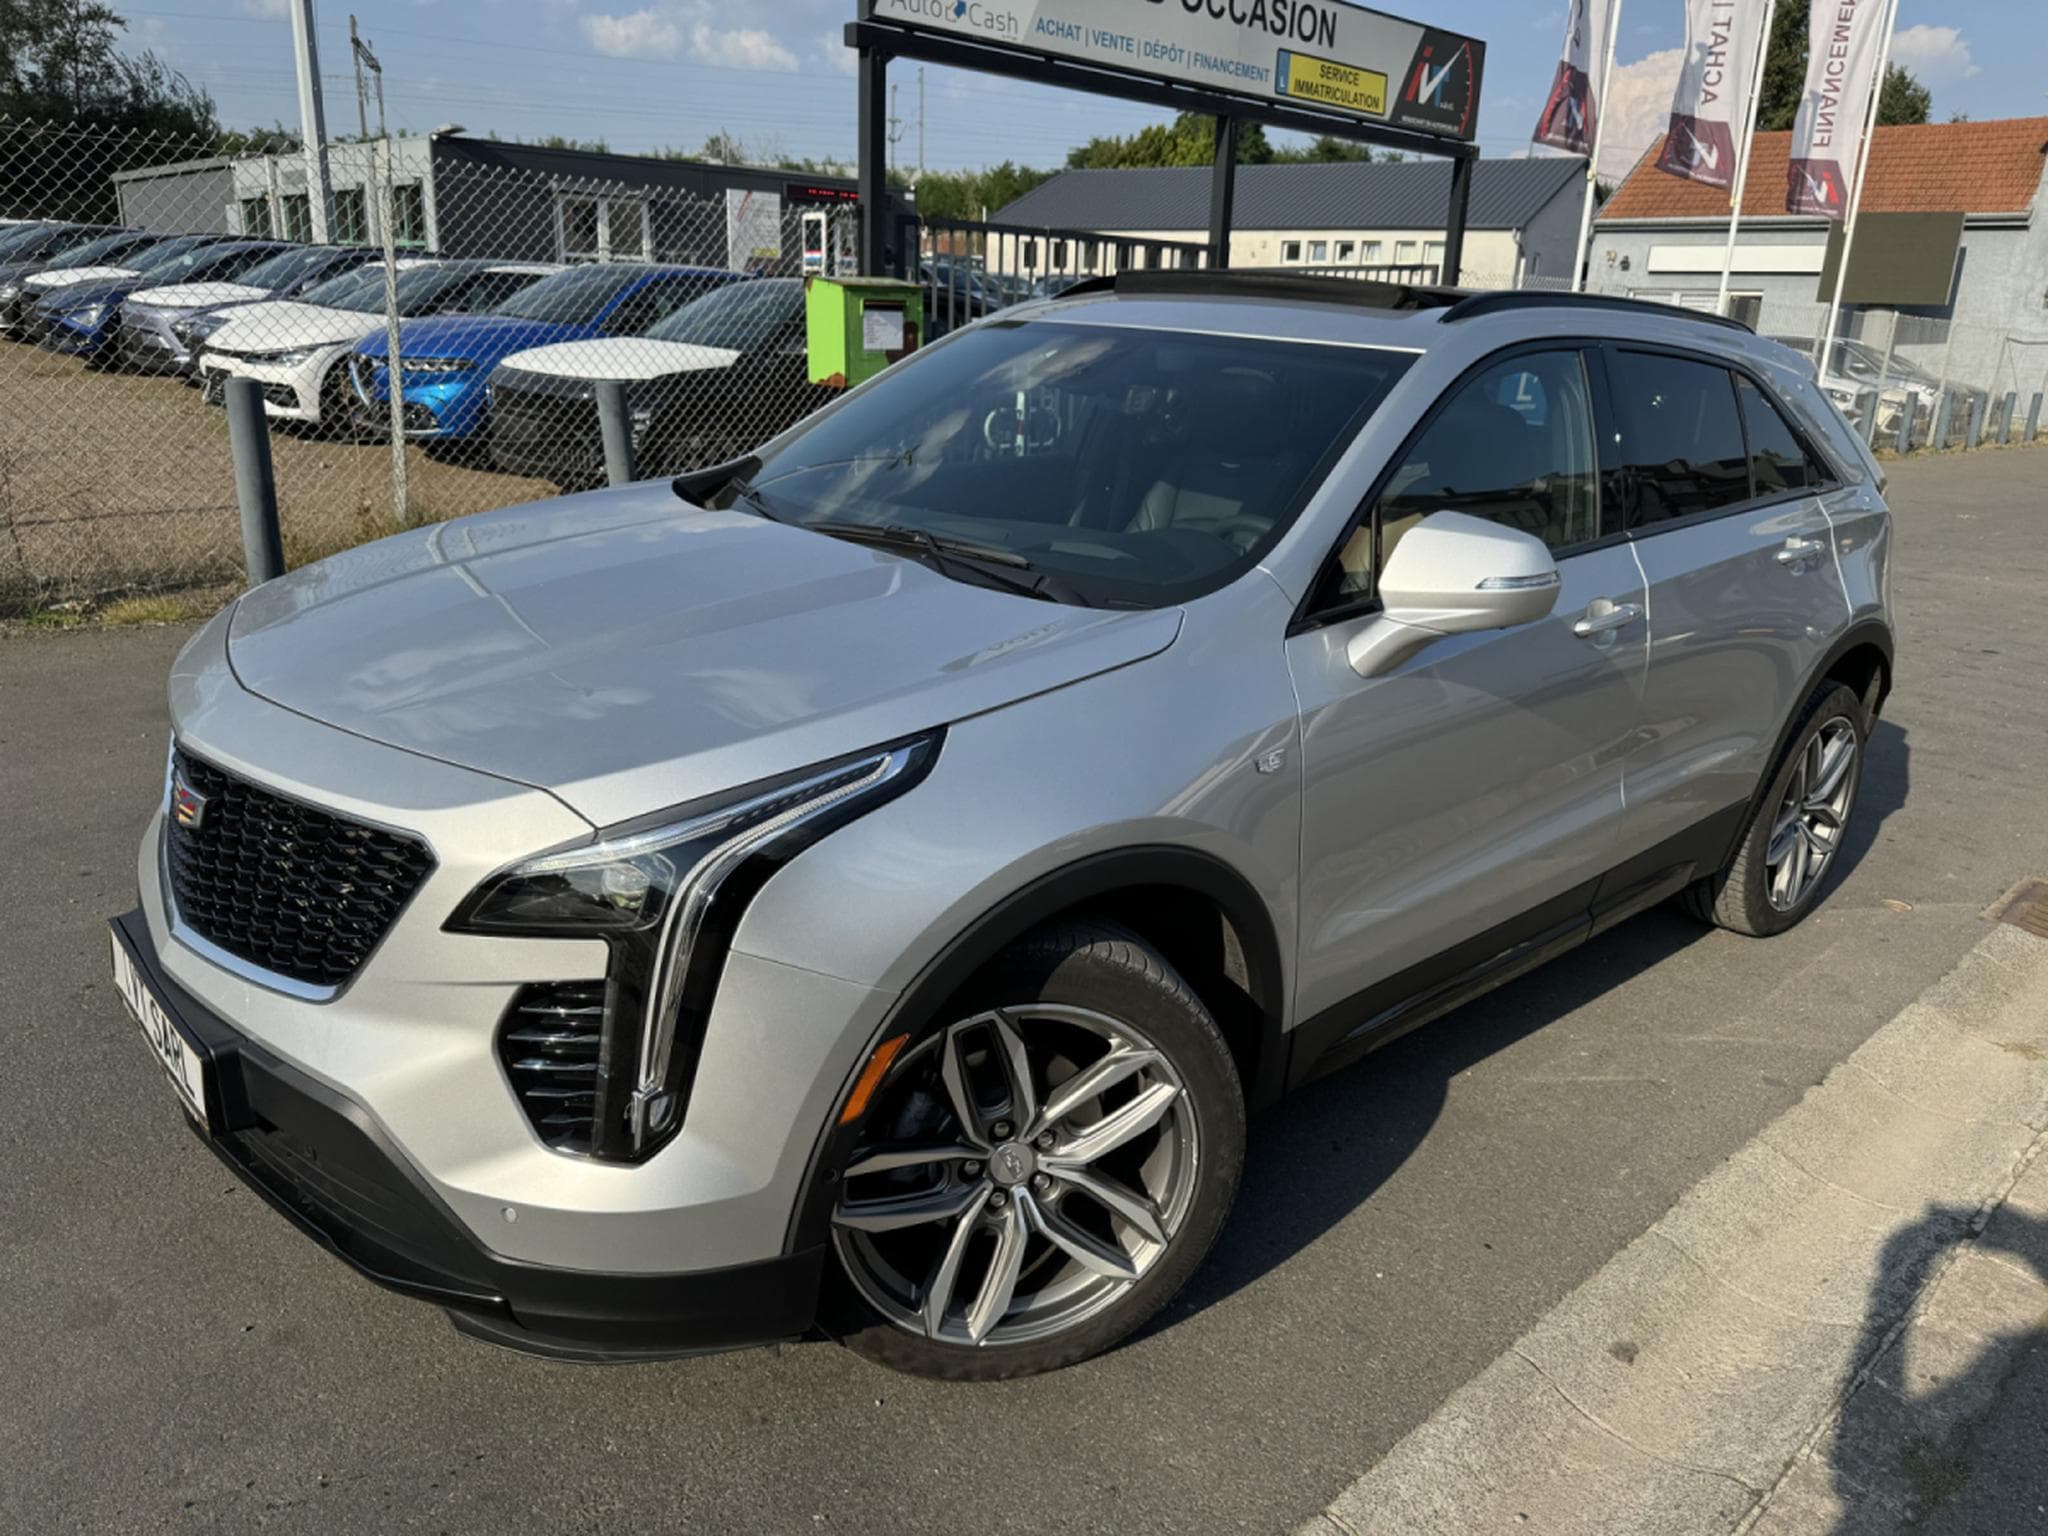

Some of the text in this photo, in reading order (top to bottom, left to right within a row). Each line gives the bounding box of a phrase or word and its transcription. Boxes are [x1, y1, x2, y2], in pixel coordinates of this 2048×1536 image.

[968, 2, 1019, 35] Cash
[1035, 16, 1270, 83] ACHAT VENTE DÉPÔT FINANCEMENT
[1319, 63, 1361, 87] SERVICE
[1293, 78, 1380, 110] IMMATRICULATION
[150, 997, 196, 1099] SARL
